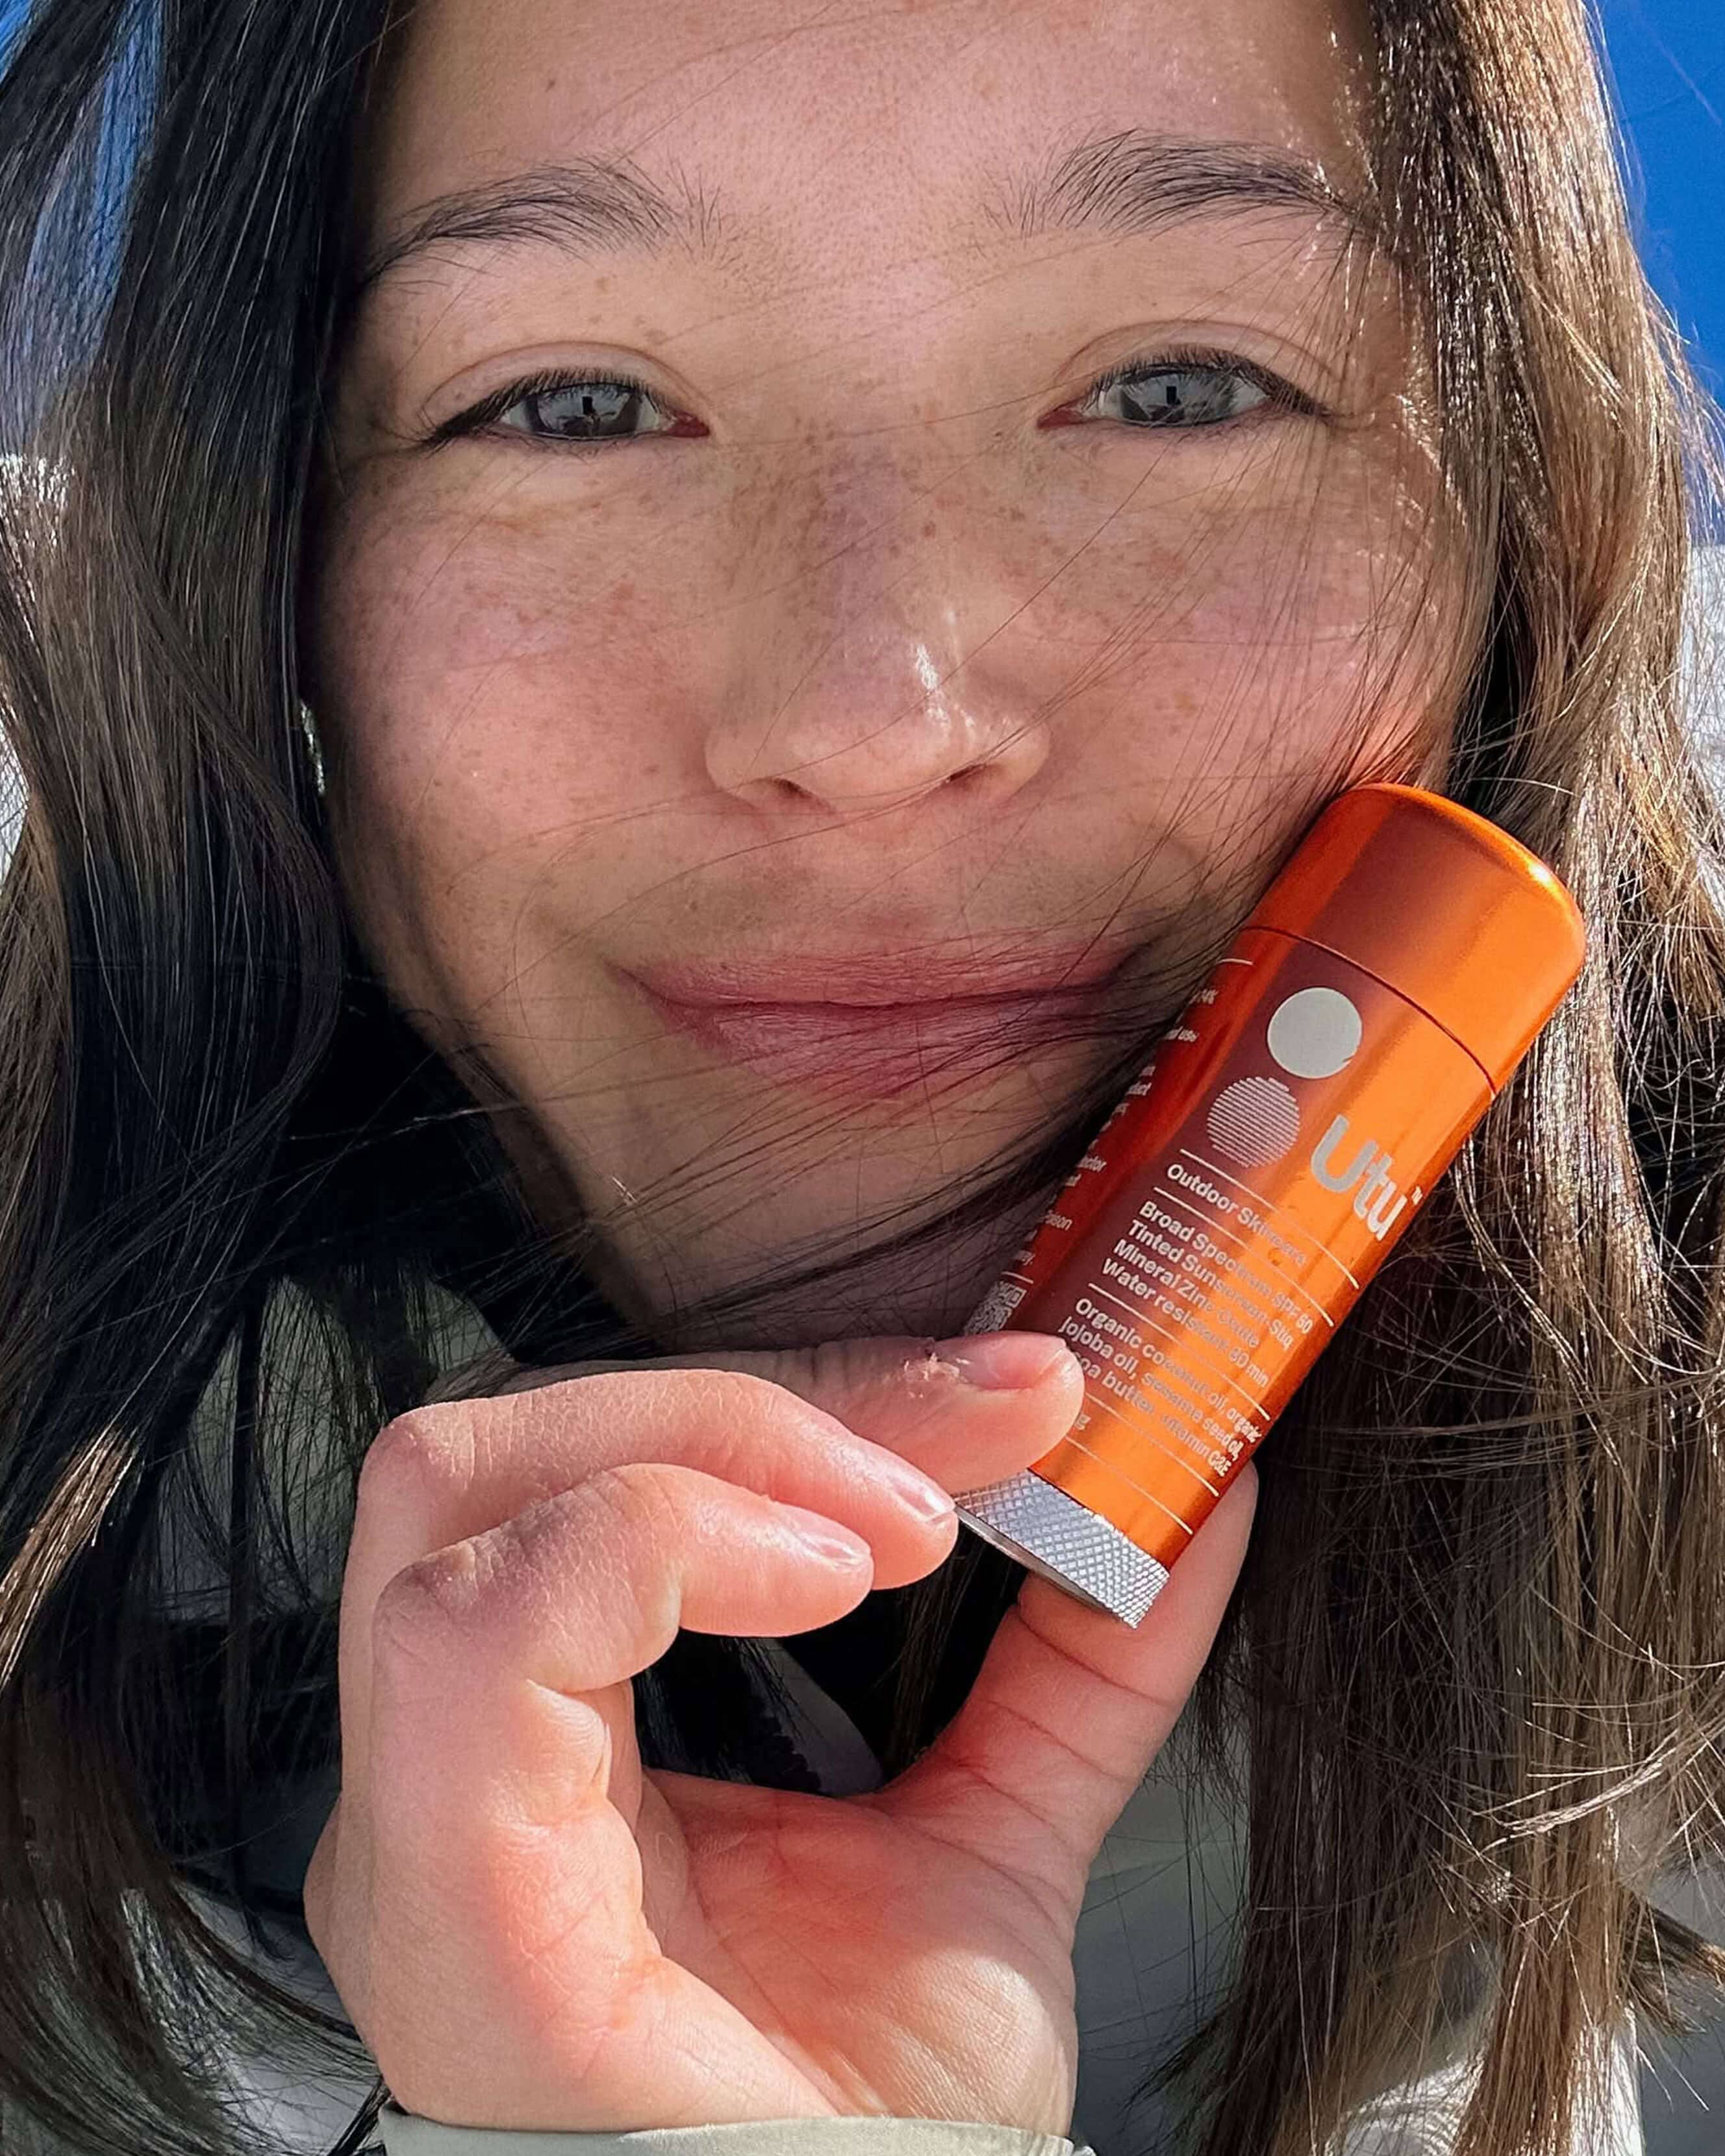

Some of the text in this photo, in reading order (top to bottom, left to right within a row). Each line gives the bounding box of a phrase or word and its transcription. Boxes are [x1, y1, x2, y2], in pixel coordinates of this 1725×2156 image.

[1139, 1201, 1196, 1242] Broad
[1167, 1164, 1239, 1213] Outdoor
[1113, 1238, 1182, 1288] Mineral
[1176, 1279, 1216, 1312] Zinc
[1128, 1219, 1185, 1263] Tinted
[1076, 1298, 1142, 1349] Organic
[1142, 1344, 1211, 1395] coconut
[1102, 1258, 1156, 1299] Water
[1246, 1362, 1269, 1388] min
[1058, 1316, 1114, 1359] jojoba
[1113, 1353, 1139, 1380] oil,
[1141, 1372, 1203, 1424] sesame
[1202, 1418, 1233, 1448] seed
